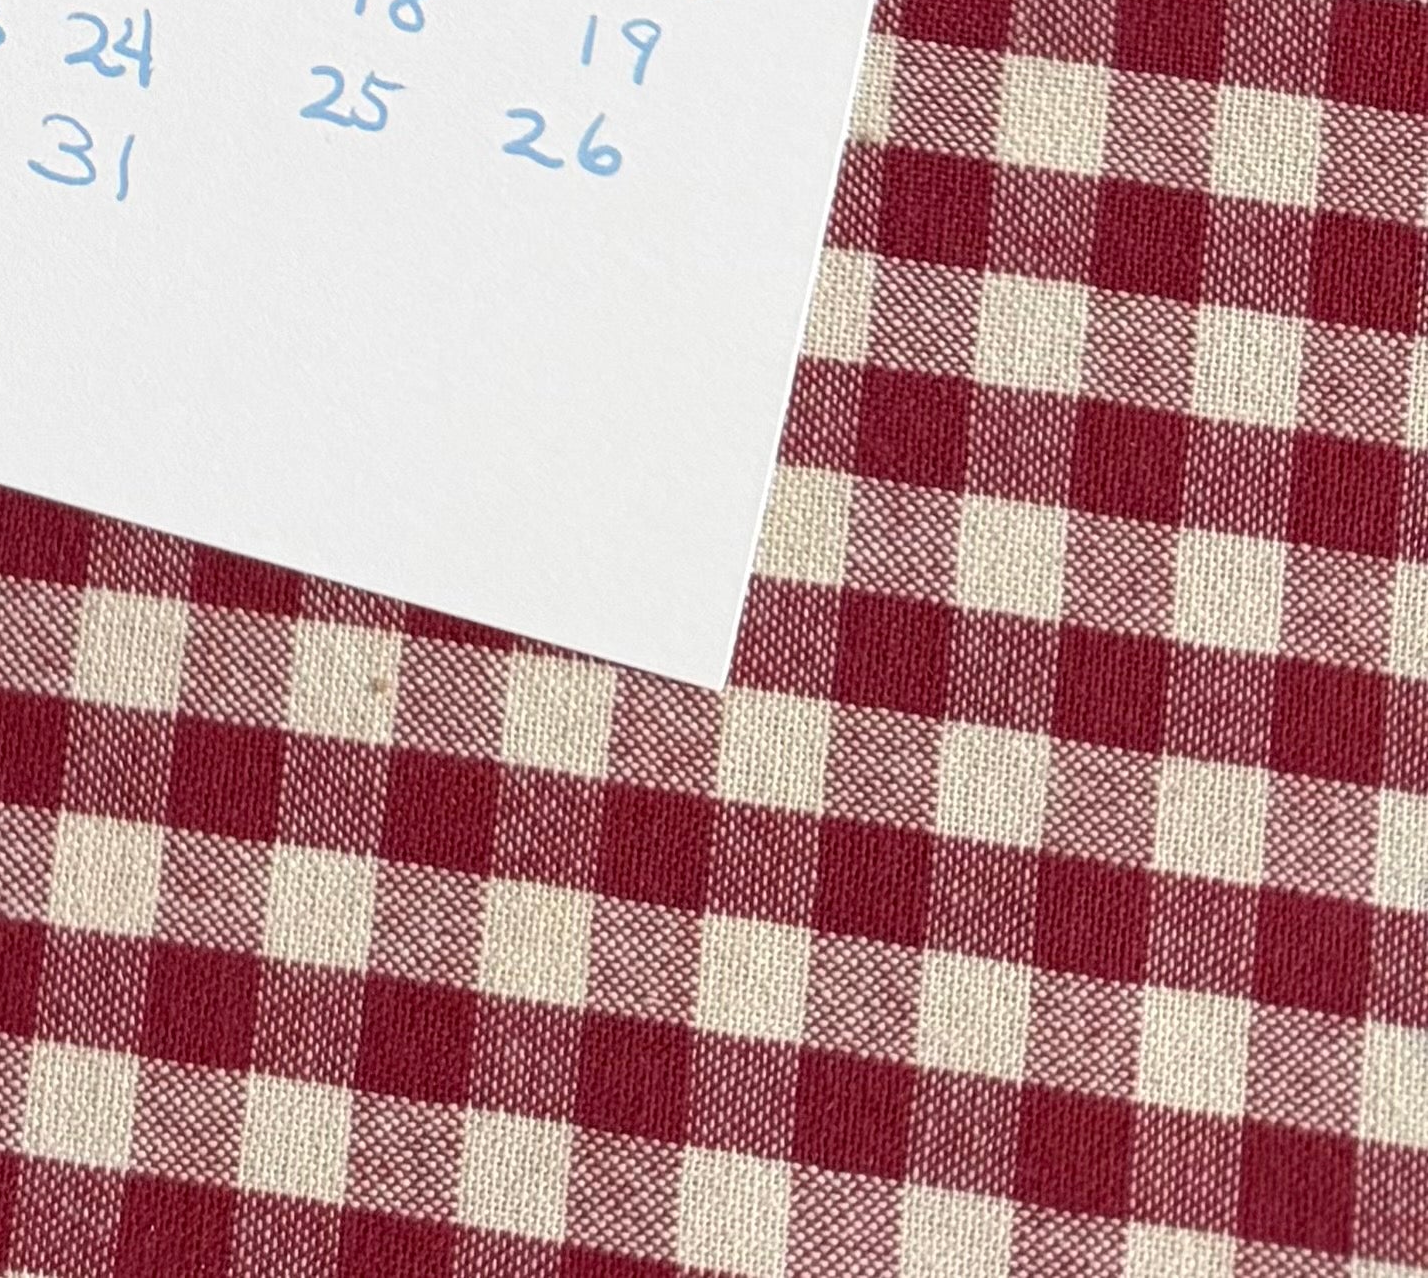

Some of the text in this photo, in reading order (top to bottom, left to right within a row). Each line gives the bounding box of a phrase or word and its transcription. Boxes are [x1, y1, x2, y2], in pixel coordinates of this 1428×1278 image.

[63, 8, 154, 90] 24
[299, 65, 407, 133] 25
[501, 107, 623, 178] 26
[580, 14, 662, 86] 19
[26, 113, 136, 203] 31
